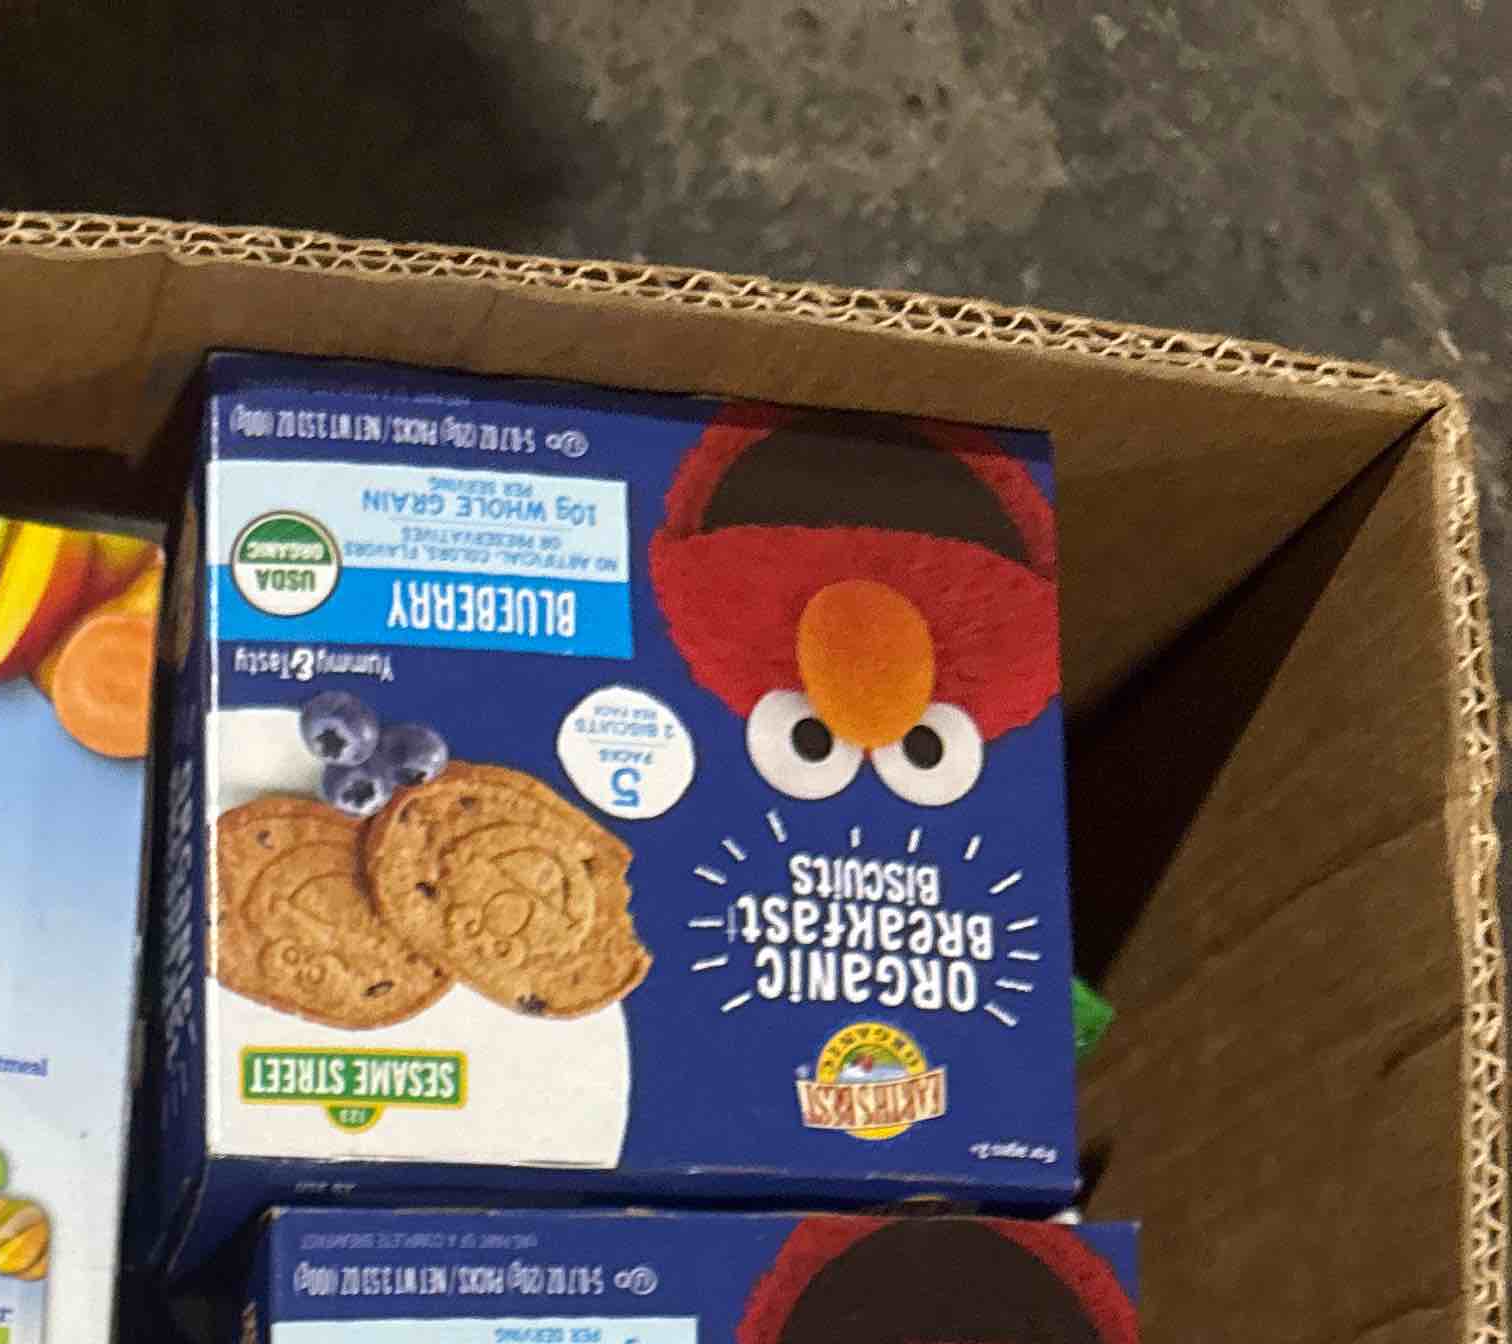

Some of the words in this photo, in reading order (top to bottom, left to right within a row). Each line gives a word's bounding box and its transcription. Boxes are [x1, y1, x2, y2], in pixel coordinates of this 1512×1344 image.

[359, 489, 446, 516] GRAIN
[453, 499, 548, 523] WHOLE
[554, 496, 599, 528] 10g
[253, 566, 318, 593] USDA
[385, 577, 578, 638] BLUEBERRY
[232, 647, 290, 679] Tasty
[316, 649, 395, 683] Yummy
[574, 716, 659, 738] BISCUITS
[610, 766, 641, 807] 5
[248, 1056, 346, 1097] STREET
[352, 1058, 457, 1098] SESAME
